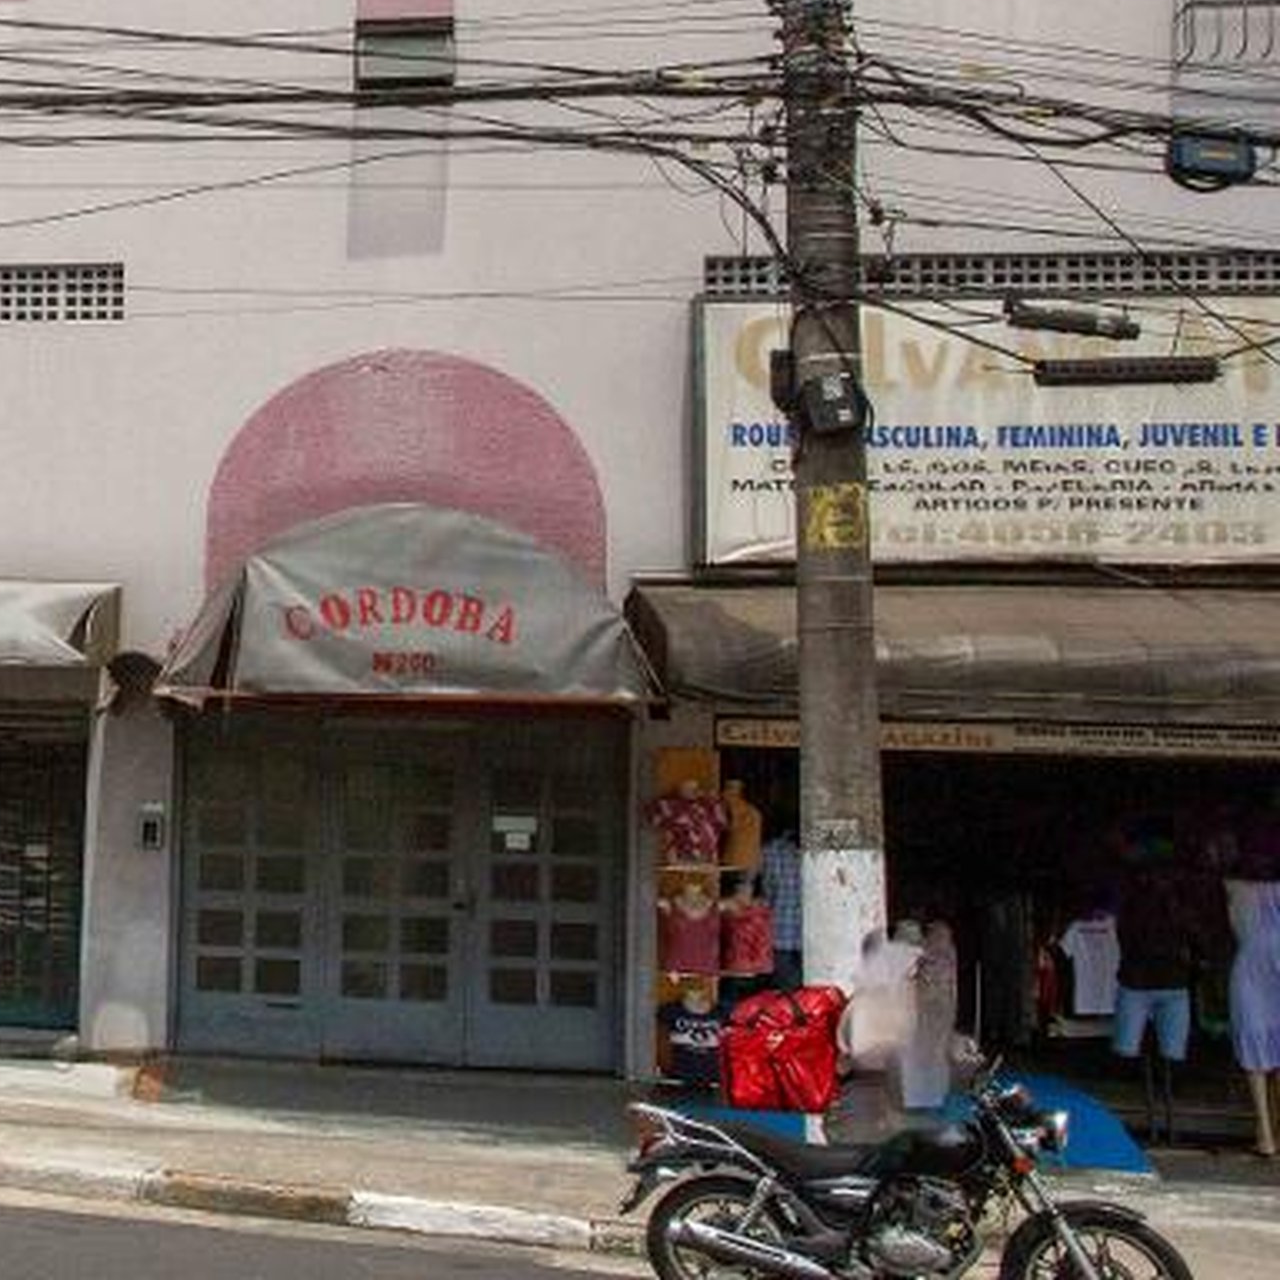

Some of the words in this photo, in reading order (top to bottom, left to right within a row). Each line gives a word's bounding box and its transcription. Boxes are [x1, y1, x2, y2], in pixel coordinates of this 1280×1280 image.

[862, 425, 989, 452] ASCULINA,
[997, 423, 1130, 450] FEMININA,
[1139, 422, 1244, 448] JUVENIL
[1253, 423, 1268, 447] E
[1068, 496, 1204, 512] PRESENTE
[285, 585, 517, 645] CORDOBA
